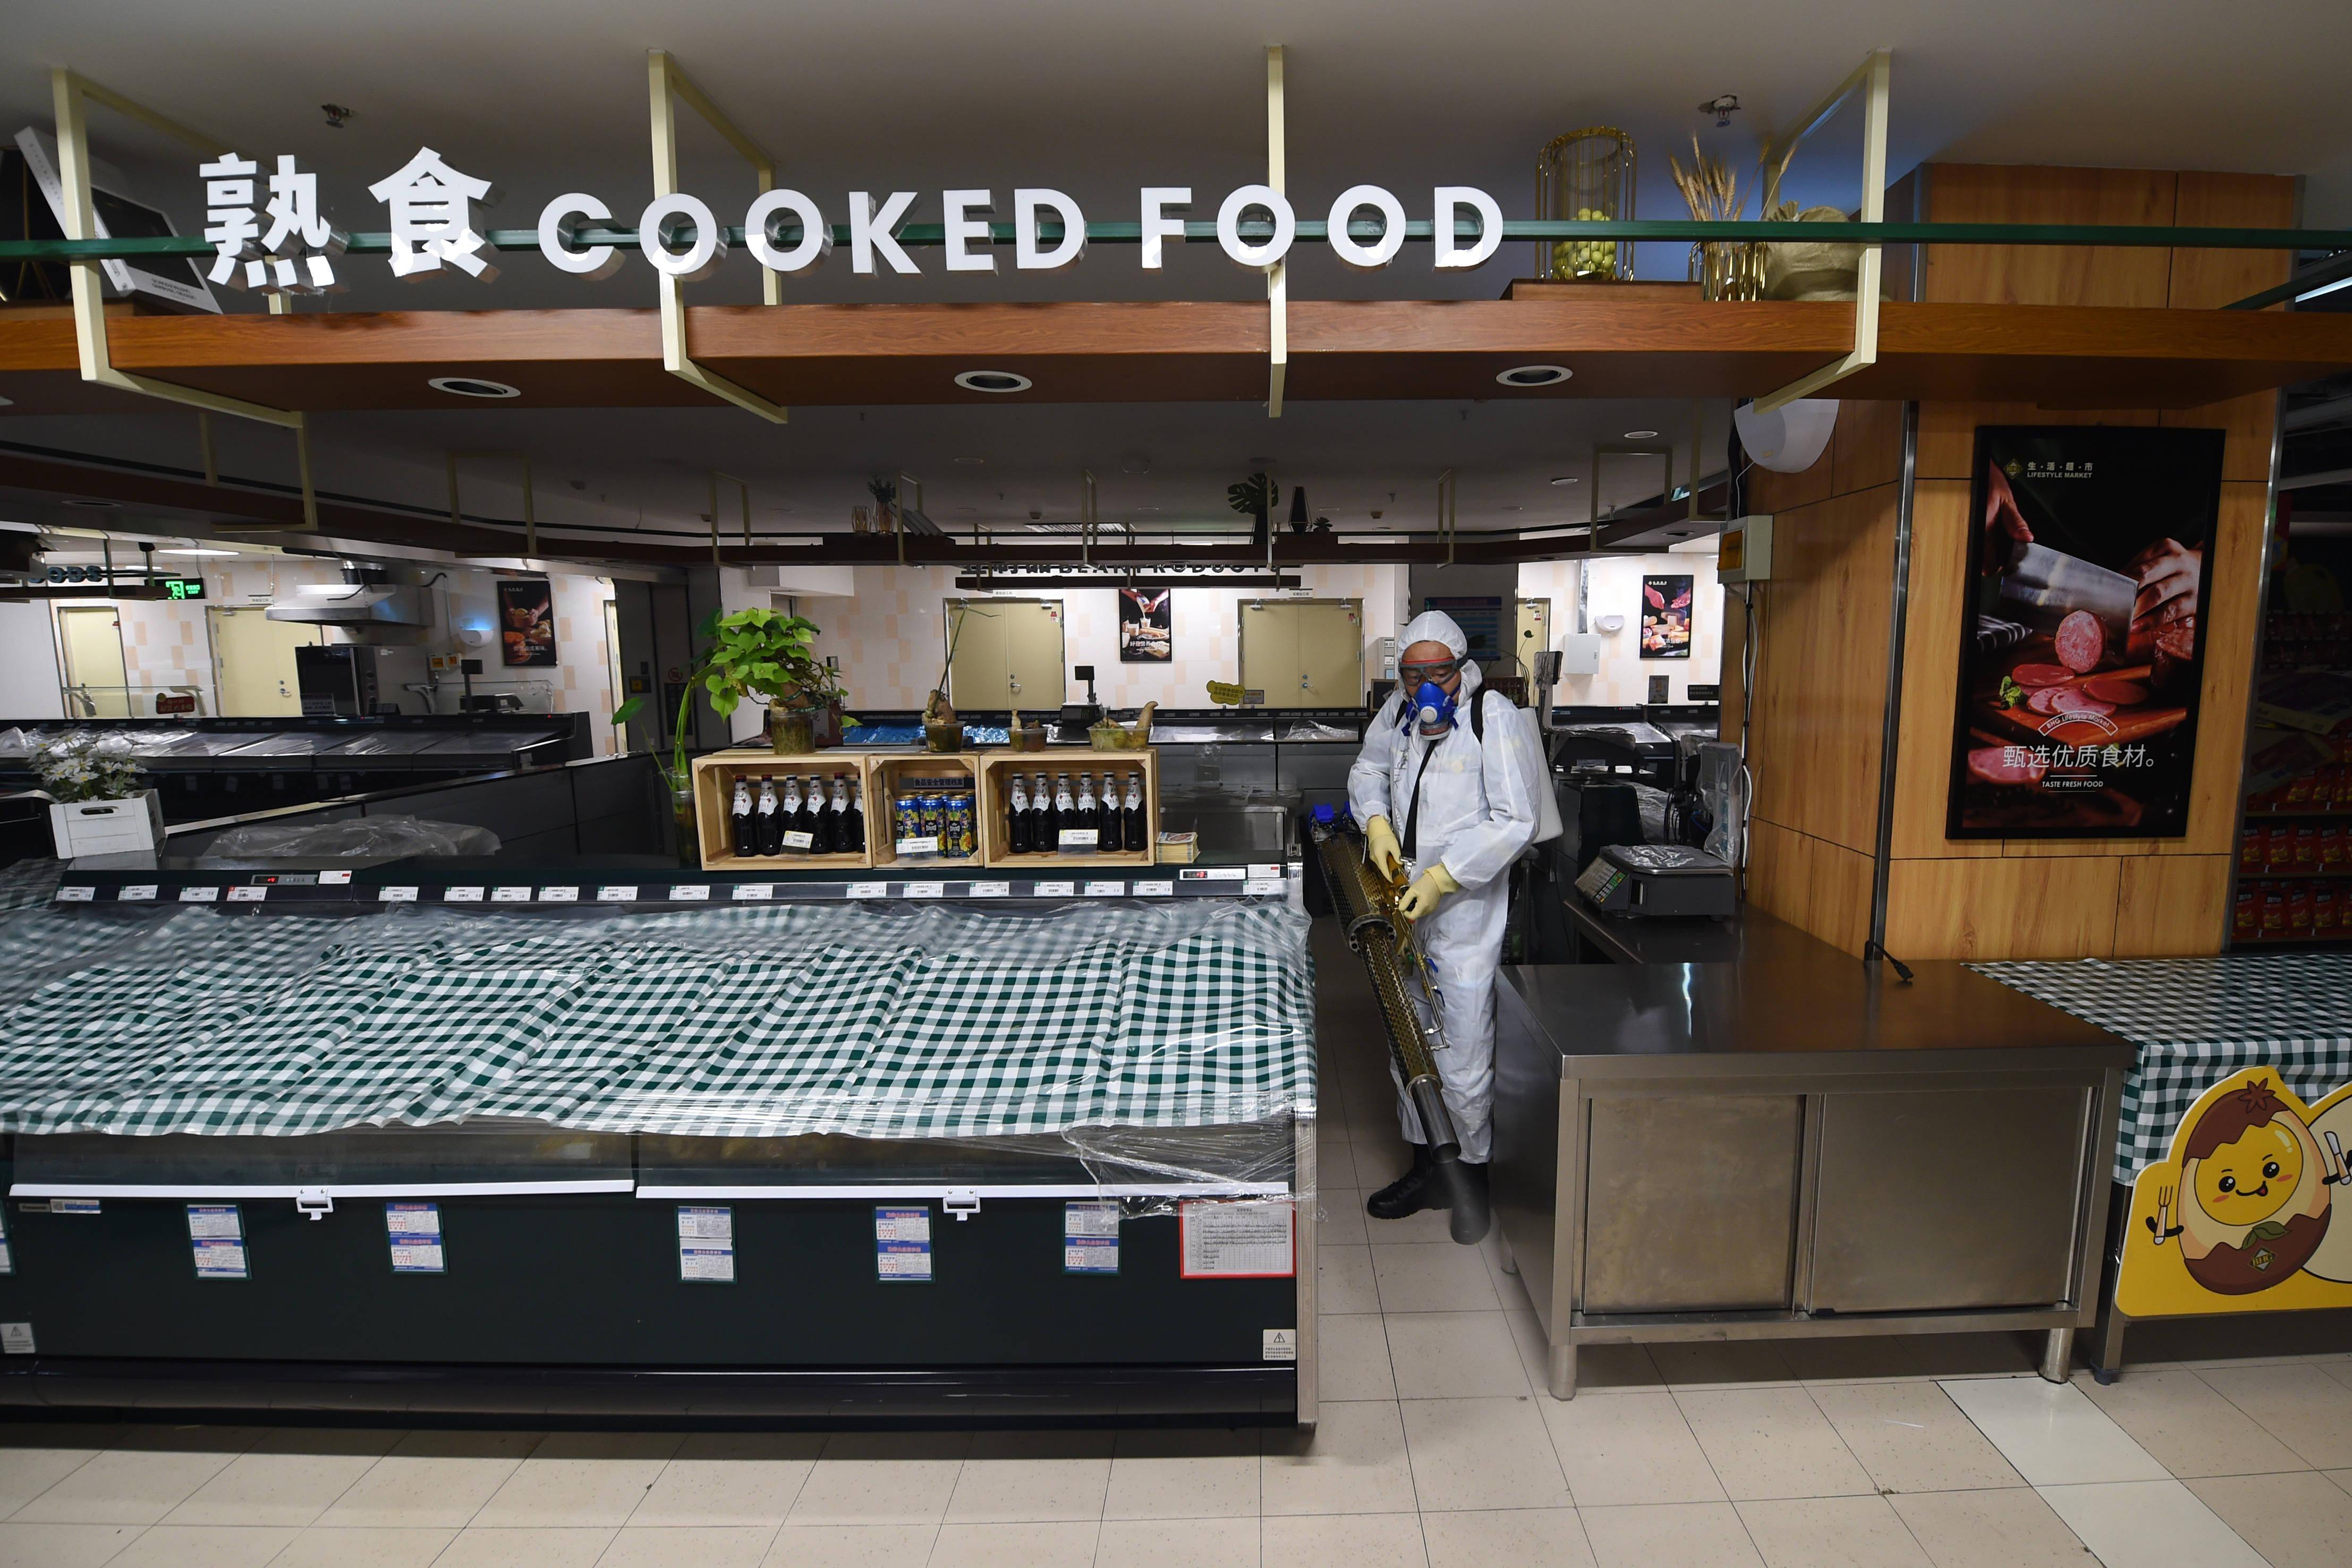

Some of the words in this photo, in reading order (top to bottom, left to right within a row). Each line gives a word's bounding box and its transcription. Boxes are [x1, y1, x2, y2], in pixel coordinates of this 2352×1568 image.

[538, 189, 1084, 274] COOKED
[1141, 184, 1503, 268] FOOD
[28, 565, 103, 583] ODS
[2046, 717, 2061, 729] BHG
[2062, 713, 2087, 722] Lifestyle
[2088, 715, 2110, 728] Market
[2002, 744, 2154, 768] 甄选优质食材。
[2251, 1252, 2273, 1267] BHG
